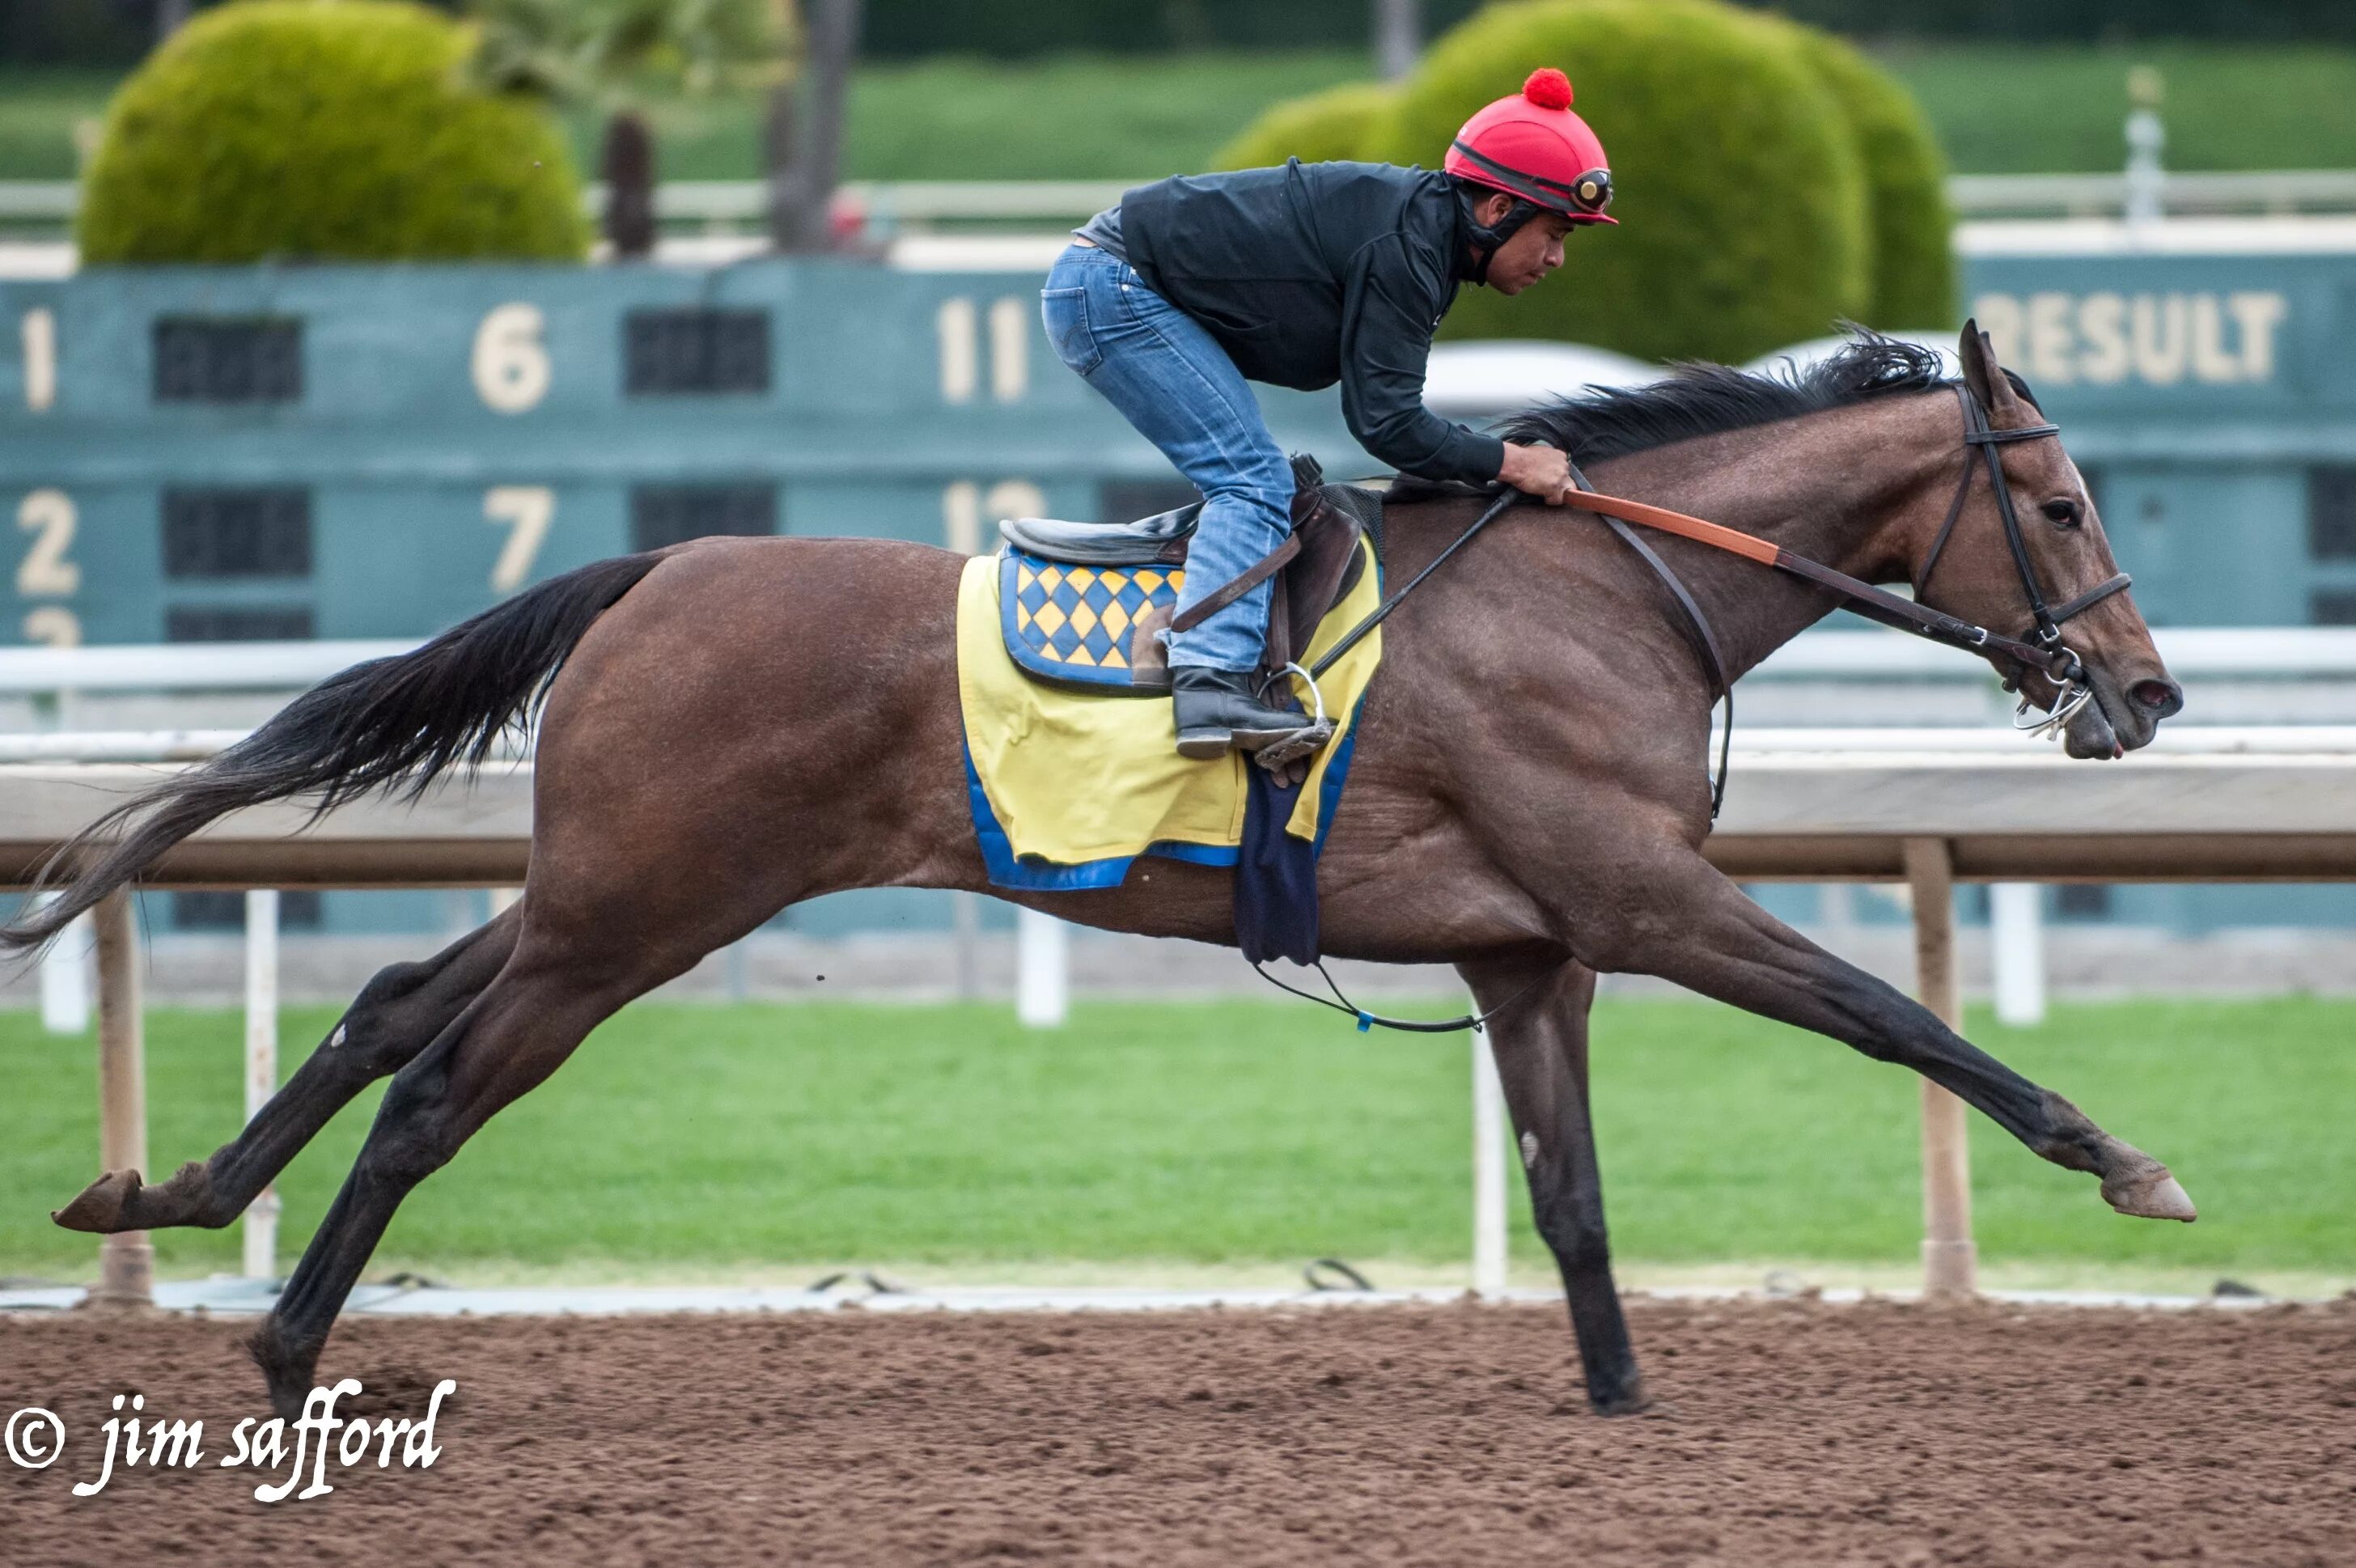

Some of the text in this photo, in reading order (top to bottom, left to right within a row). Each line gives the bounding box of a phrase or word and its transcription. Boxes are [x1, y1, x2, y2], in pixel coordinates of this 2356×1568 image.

[21, 307, 56, 411] 1
[471, 303, 552, 413] 6
[939, 296, 1029, 401] 11
[1973, 291, 2288, 384] RESULT
[16, 489, 78, 597] 2
[484, 485, 554, 593] 7
